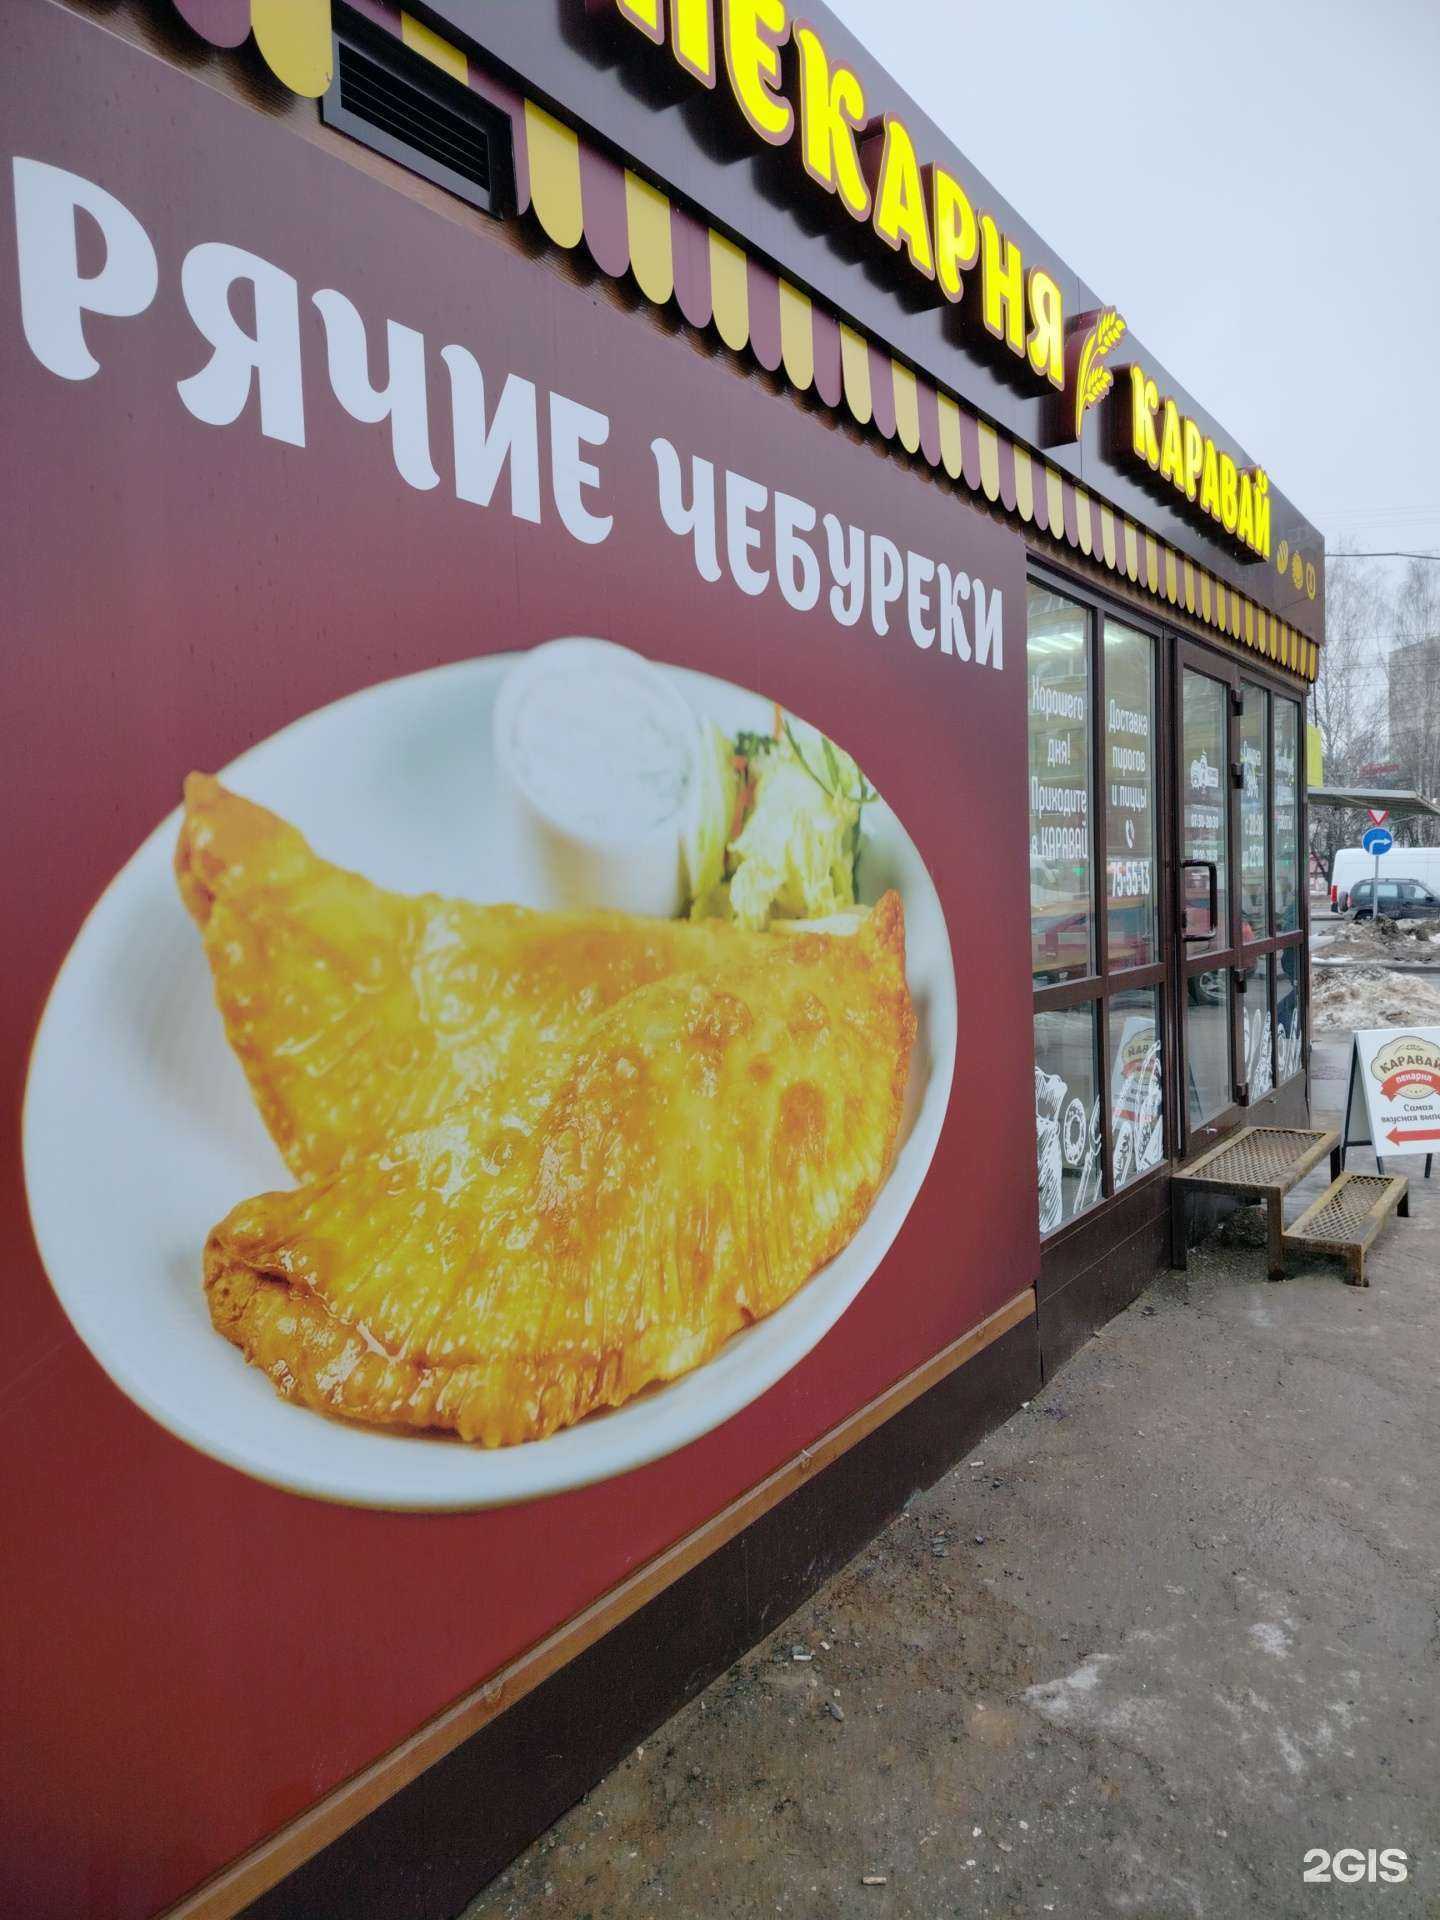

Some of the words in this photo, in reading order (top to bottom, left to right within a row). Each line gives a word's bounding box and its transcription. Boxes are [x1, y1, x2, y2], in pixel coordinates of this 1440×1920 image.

[12, 156, 613, 545] РЯЧИЕ
[650, 437, 1003, 670] ЧЕБУРЕКИ
[1130, 362, 1270, 562] КАРАВАЙ
[1031, 674, 1084, 722] Хорошего
[1109, 699, 1148, 737] Доставка
[1047, 732, 1071, 769] дня!
[1112, 746, 1146, 776] пирогов
[1031, 776, 1088, 819] Приходите
[1119, 785, 1148, 812] пиццы
[1041, 821, 1088, 861] КАРАВАЙ
[1403, 1104, 1433, 1112] Самая
